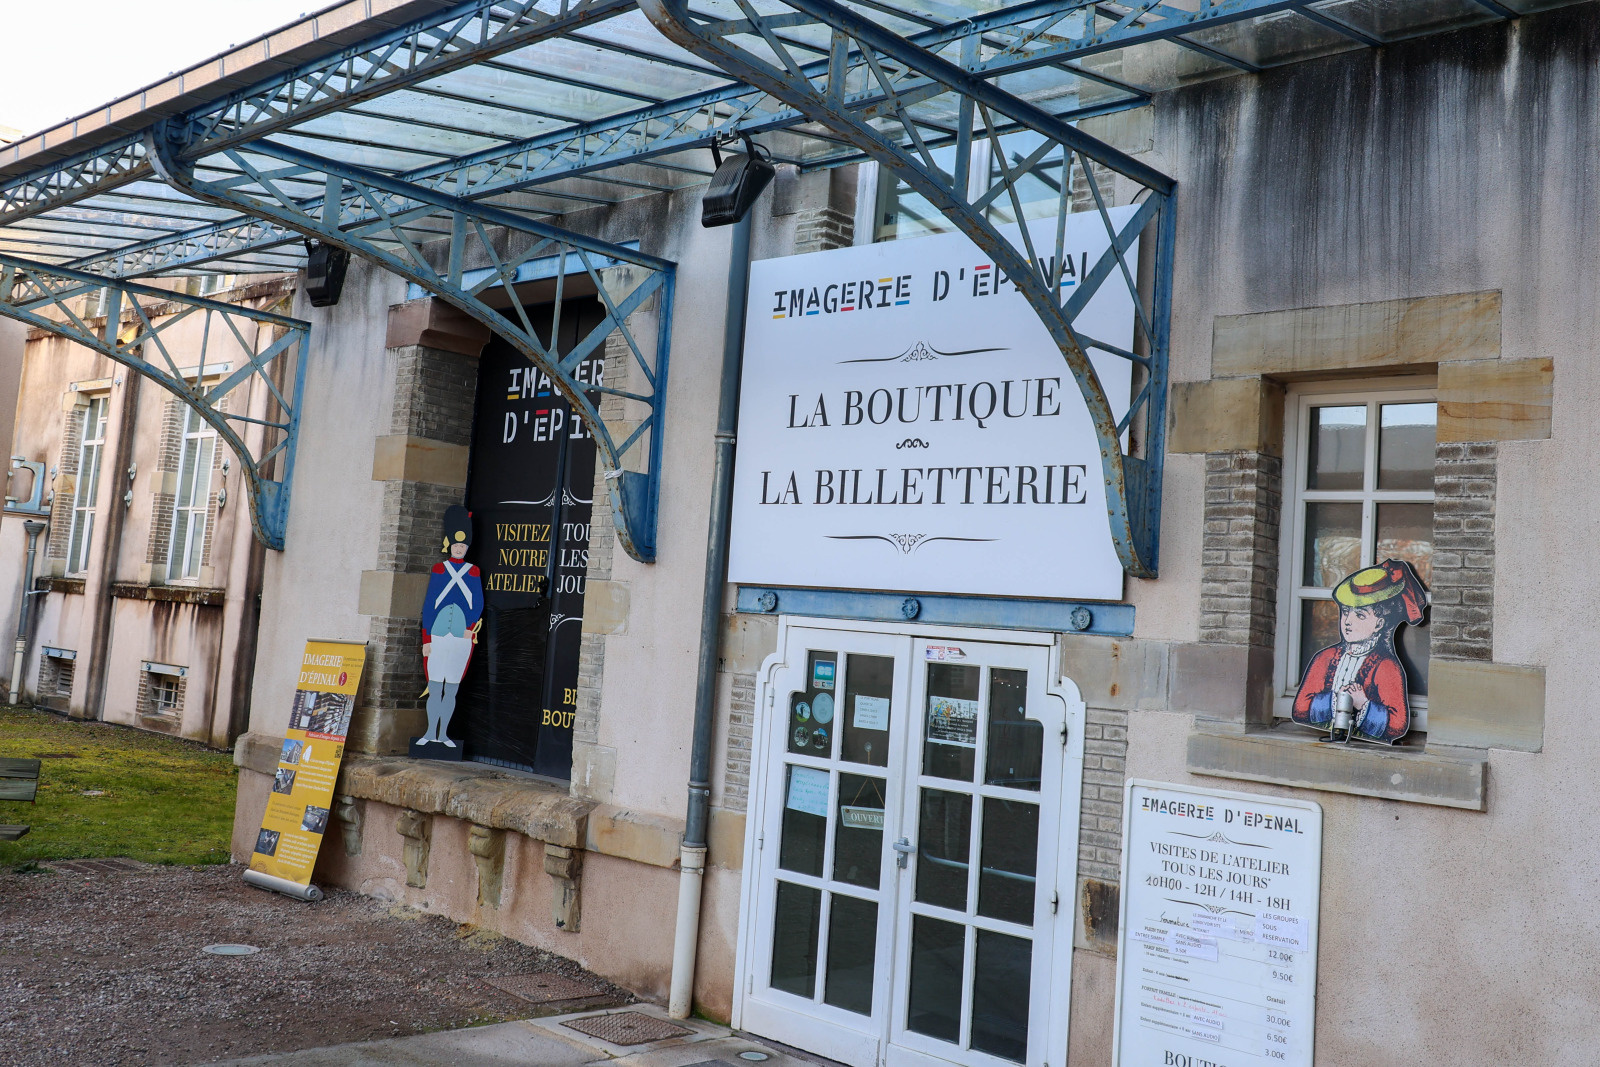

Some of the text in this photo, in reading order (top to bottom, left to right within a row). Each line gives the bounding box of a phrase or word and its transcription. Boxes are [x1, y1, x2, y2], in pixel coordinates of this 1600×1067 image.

[772, 251, 1088, 320] IMAGERIE D'EPNAL
[506, 359, 605, 400] IMAER
[786, 377, 1061, 428] LA BOUTIQUE
[759, 464, 1087, 505] LA BILLETTERIE
[496, 523, 551, 542] VISITEZ
[498, 548, 548, 568] NOTRE
[559, 549, 589, 568] LES
[303, 653, 343, 668] IMAGERIE
[1142, 797, 1303, 835] IMAGERIE D'EPINAL
[1150, 841, 1290, 876] VISITES DE L'ATELIER
[1161, 860, 1196, 876] TOUS
[1199, 867, 1223, 881] LES
[1194, 883, 1217, 897] 12H
[1230, 889, 1253, 904] 14H
[1266, 895, 1291, 911] 18H
[1262, 923, 1277, 932] SOUS
[1272, 915, 1299, 924] GROUPES
[1262, 933, 1299, 946] RESERVATION
[1268, 950, 1294, 963] 12.00€
[1272, 970, 1294, 982] 9.50€
[1266, 1014, 1292, 1027] 30.00€
[1264, 1048, 1286, 1061] 3.00€
